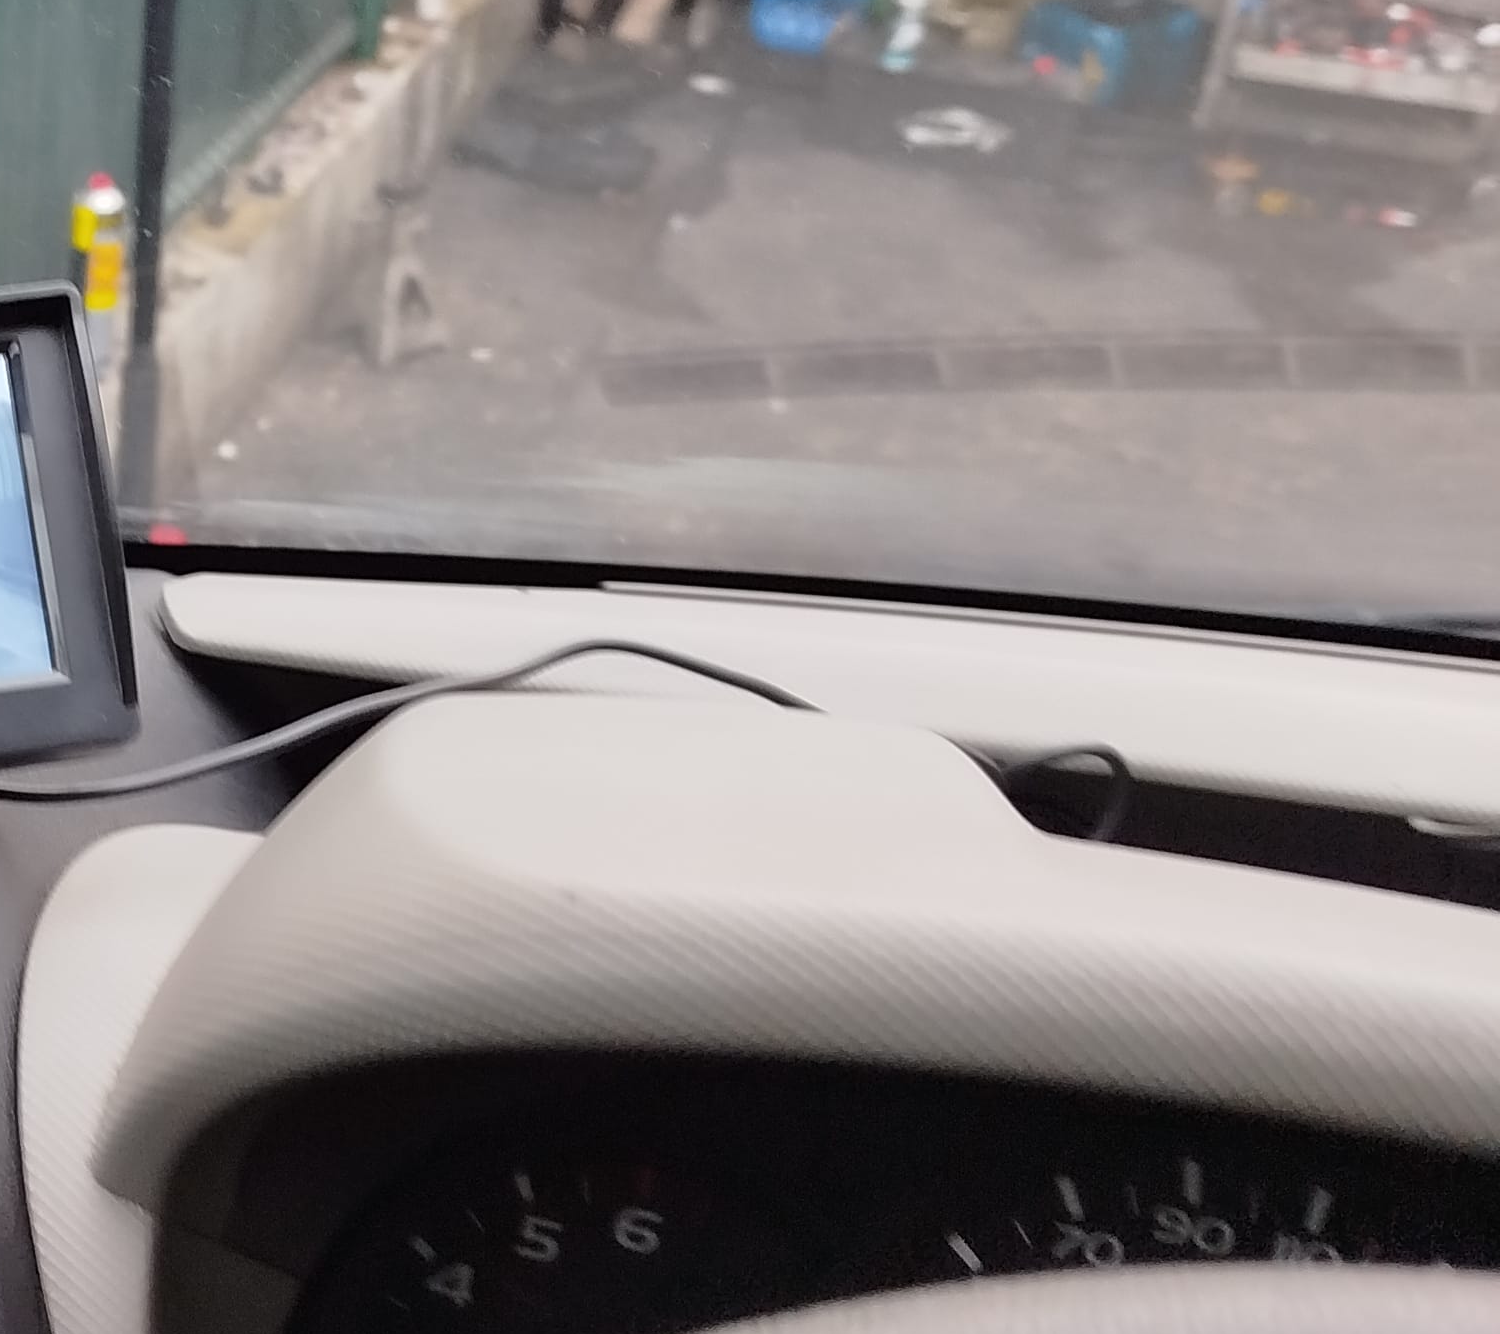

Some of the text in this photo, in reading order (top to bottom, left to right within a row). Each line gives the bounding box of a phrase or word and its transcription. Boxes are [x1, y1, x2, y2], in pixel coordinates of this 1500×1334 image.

[515, 1216, 562, 1262] 5
[612, 1208, 662, 1255] 6
[1152, 1204, 1236, 1255] 90
[426, 1263, 474, 1307] 4
